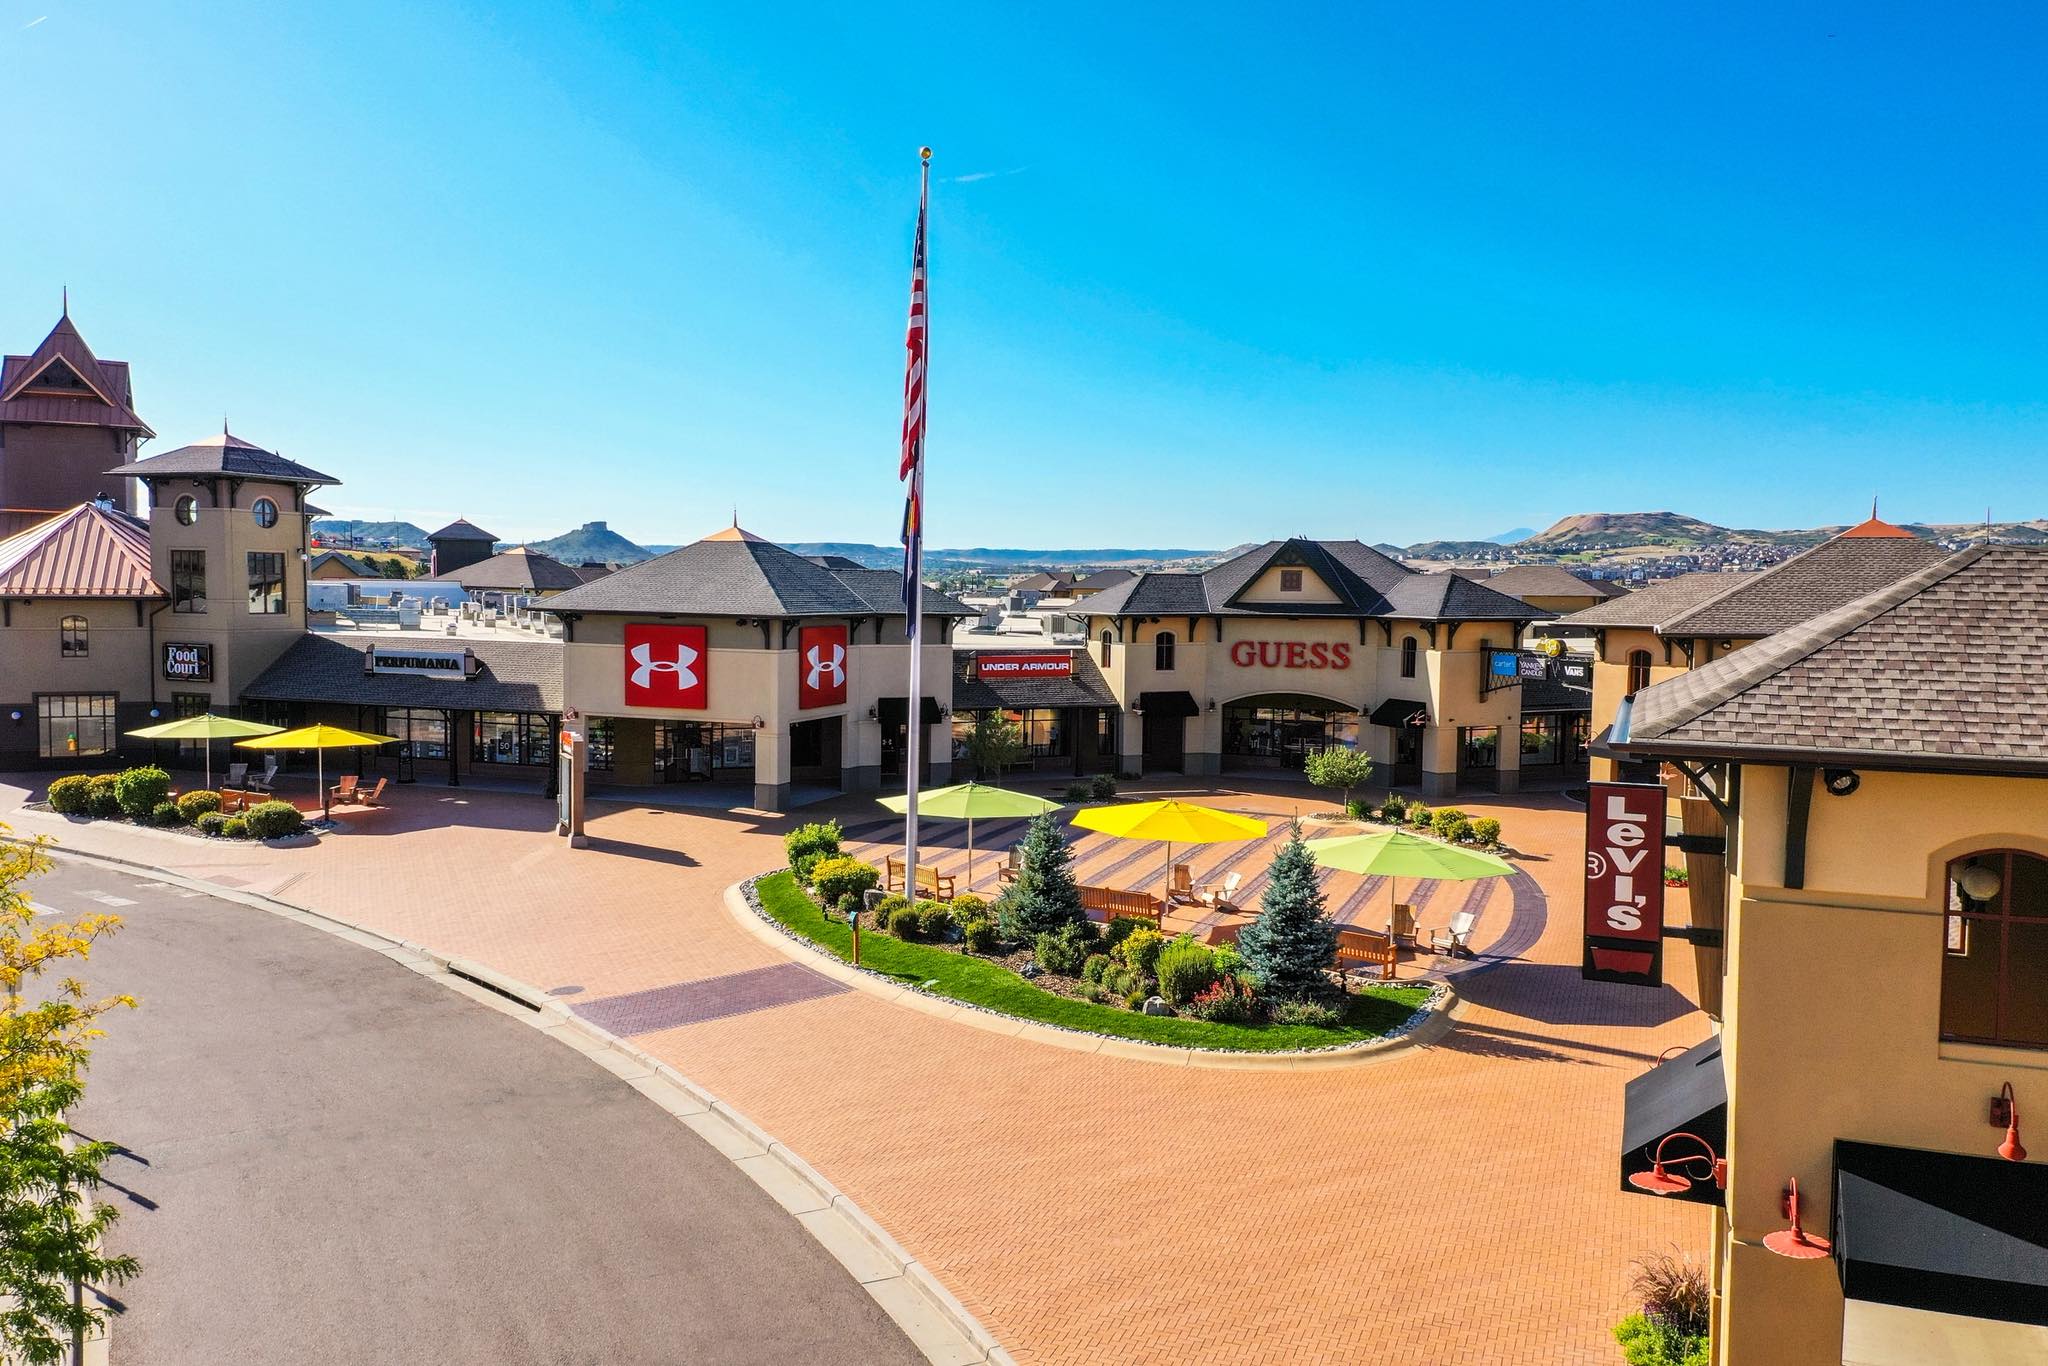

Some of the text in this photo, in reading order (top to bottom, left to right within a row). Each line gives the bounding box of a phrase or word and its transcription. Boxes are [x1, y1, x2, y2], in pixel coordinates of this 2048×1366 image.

[167, 647, 199, 662] Food
[1231, 641, 1351, 669] GUESS
[167, 661, 200, 675] Court
[374, 656, 460, 670] PERFUMANIA
[981, 662, 1069, 671] UNDER ARMOUR
[1564, 665, 1584, 677] VANS
[1605, 795, 1649, 931] Levi's
